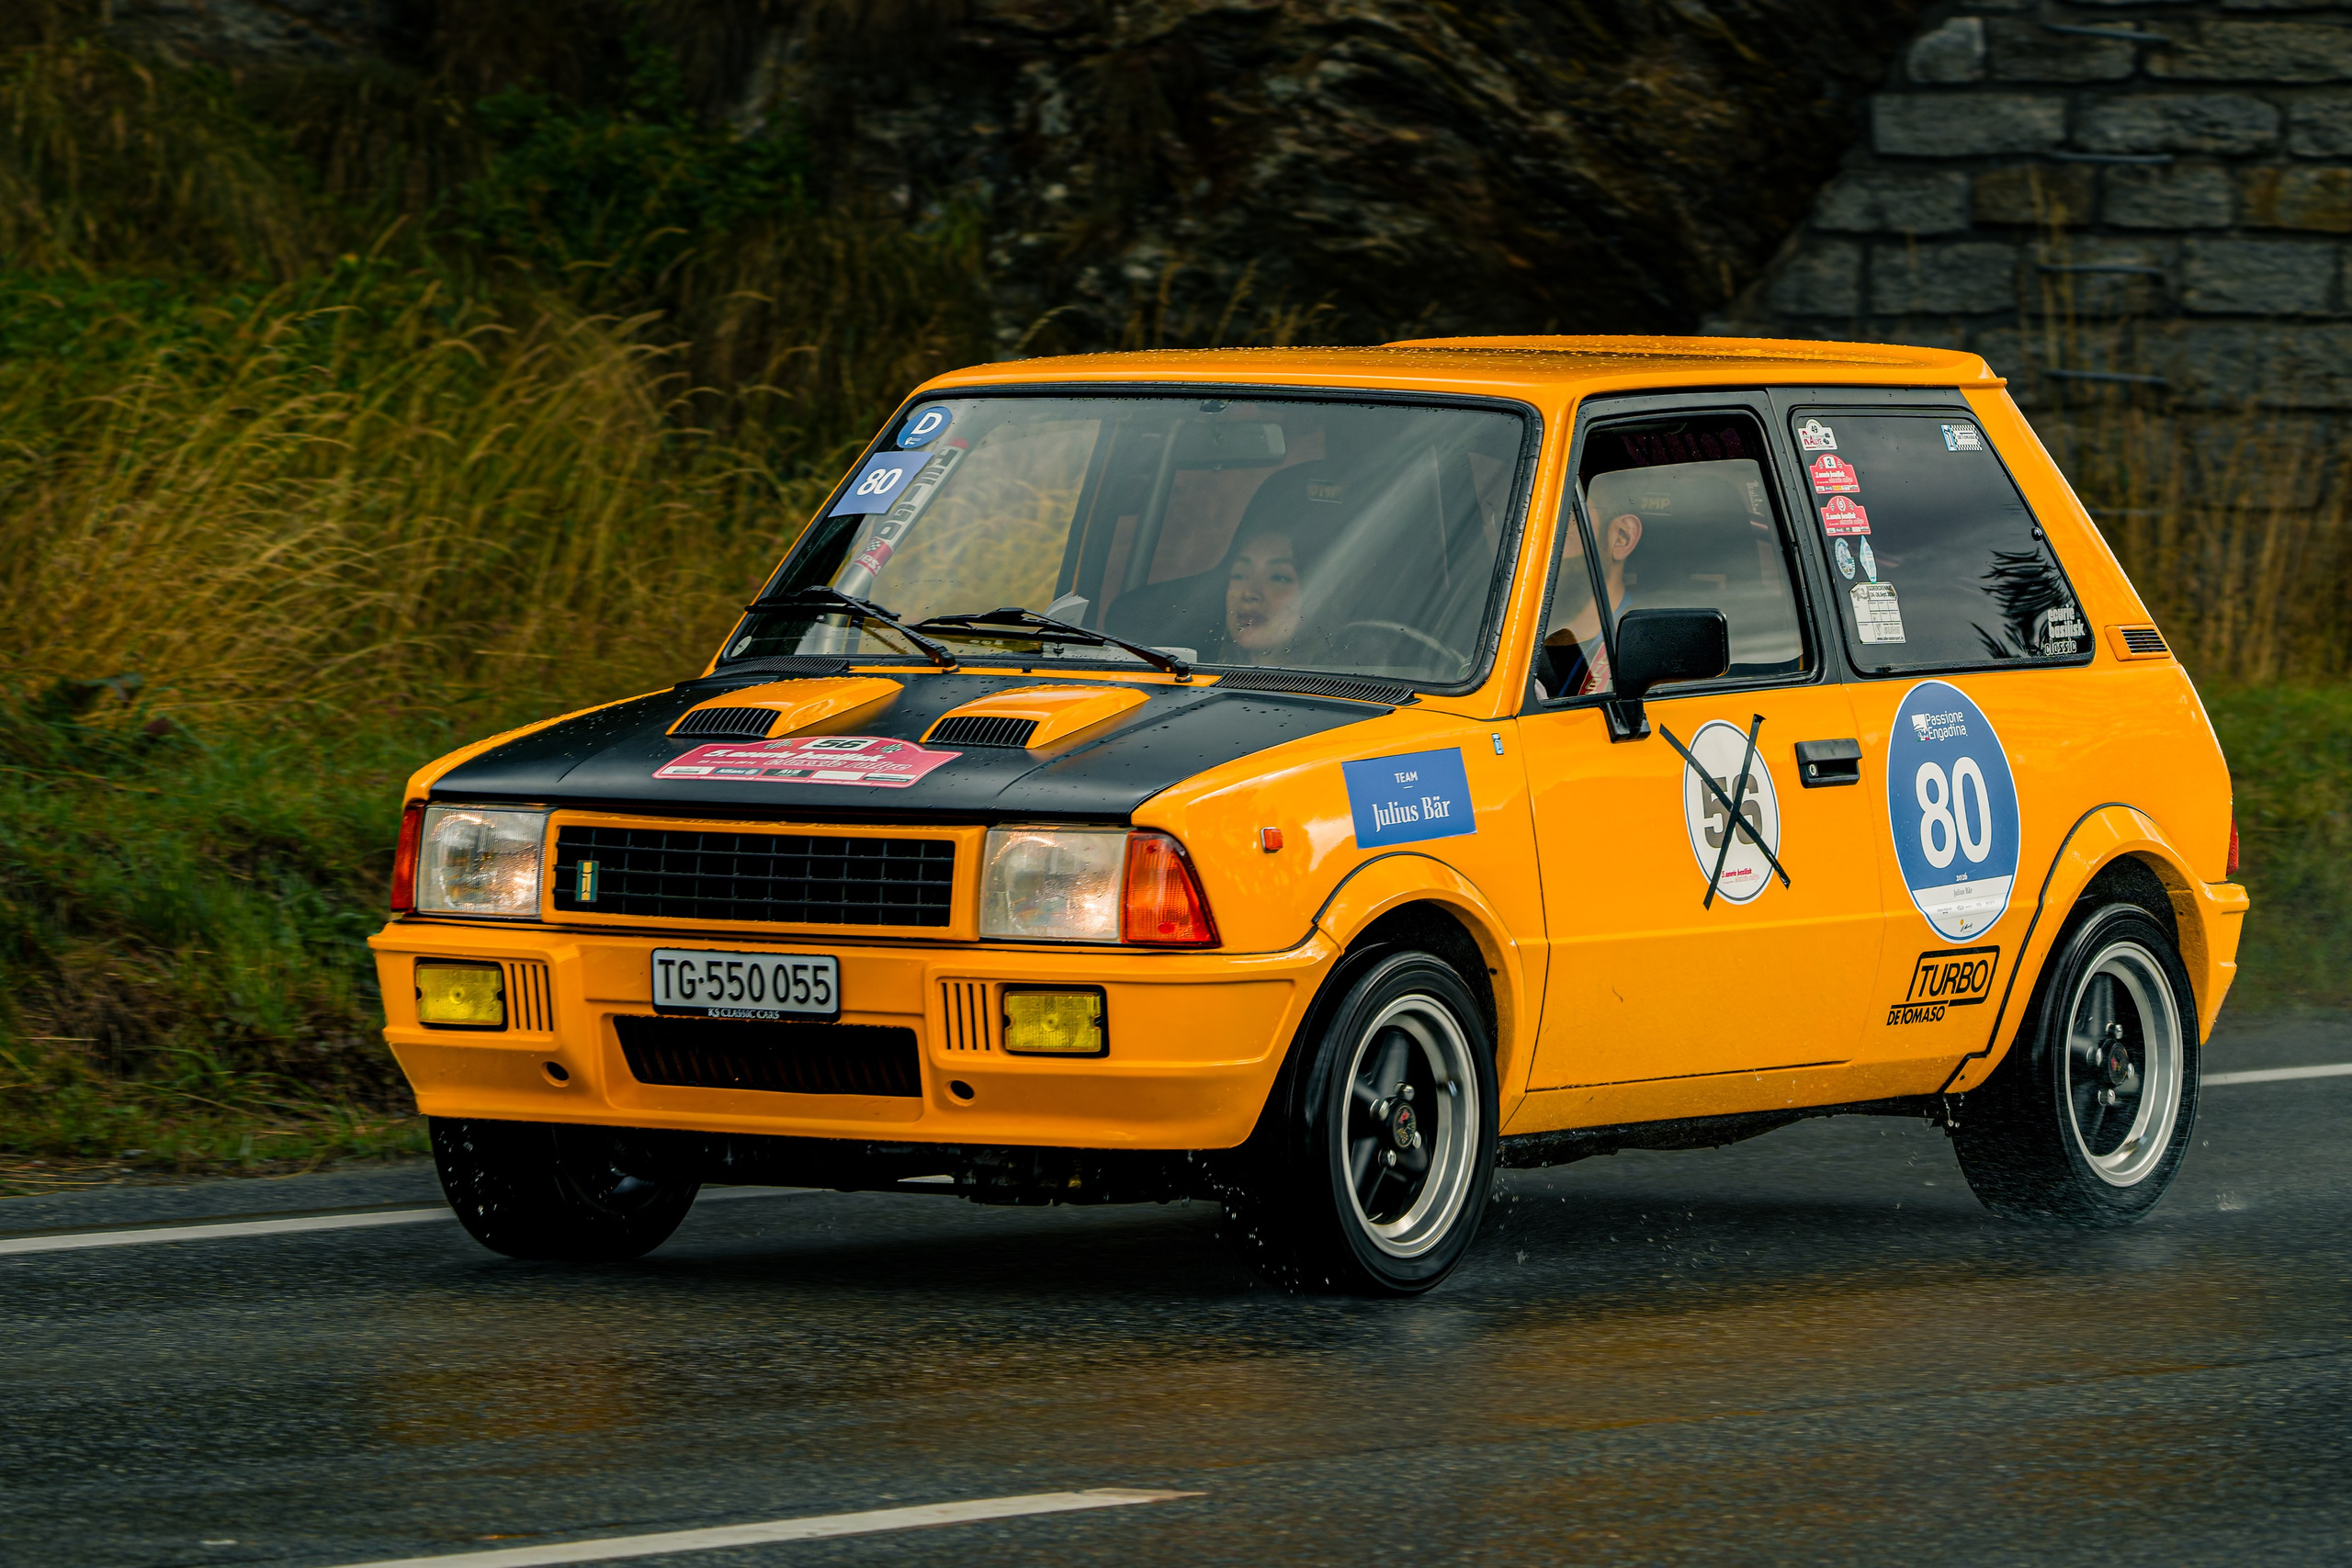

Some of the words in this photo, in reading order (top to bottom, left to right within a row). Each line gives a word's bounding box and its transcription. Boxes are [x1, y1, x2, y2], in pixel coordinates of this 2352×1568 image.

[910, 412, 943, 434] D
[856, 468, 903, 496] 80
[2047, 604, 2075, 621] ecurie
[2048, 619, 2086, 638] basilisk
[2044, 637, 2077, 656] classic
[1925, 710, 1964, 727] Passione
[1928, 723, 1967, 741] Engadina
[811, 739, 868, 749] 56
[1394, 771, 1419, 784] TEAM
[1371, 800, 1419, 833] Julius
[1420, 795, 1451, 820] Bär
[1700, 773, 1763, 849] 56
[1916, 756, 1993, 869] 80
[773, 963, 832, 1005] 055
[1918, 959, 1989, 998] TURBO
[707, 1008, 720, 1018] KS
[720, 1008, 756, 1019] CLASSIC
[756, 1010, 780, 1020] CARS
